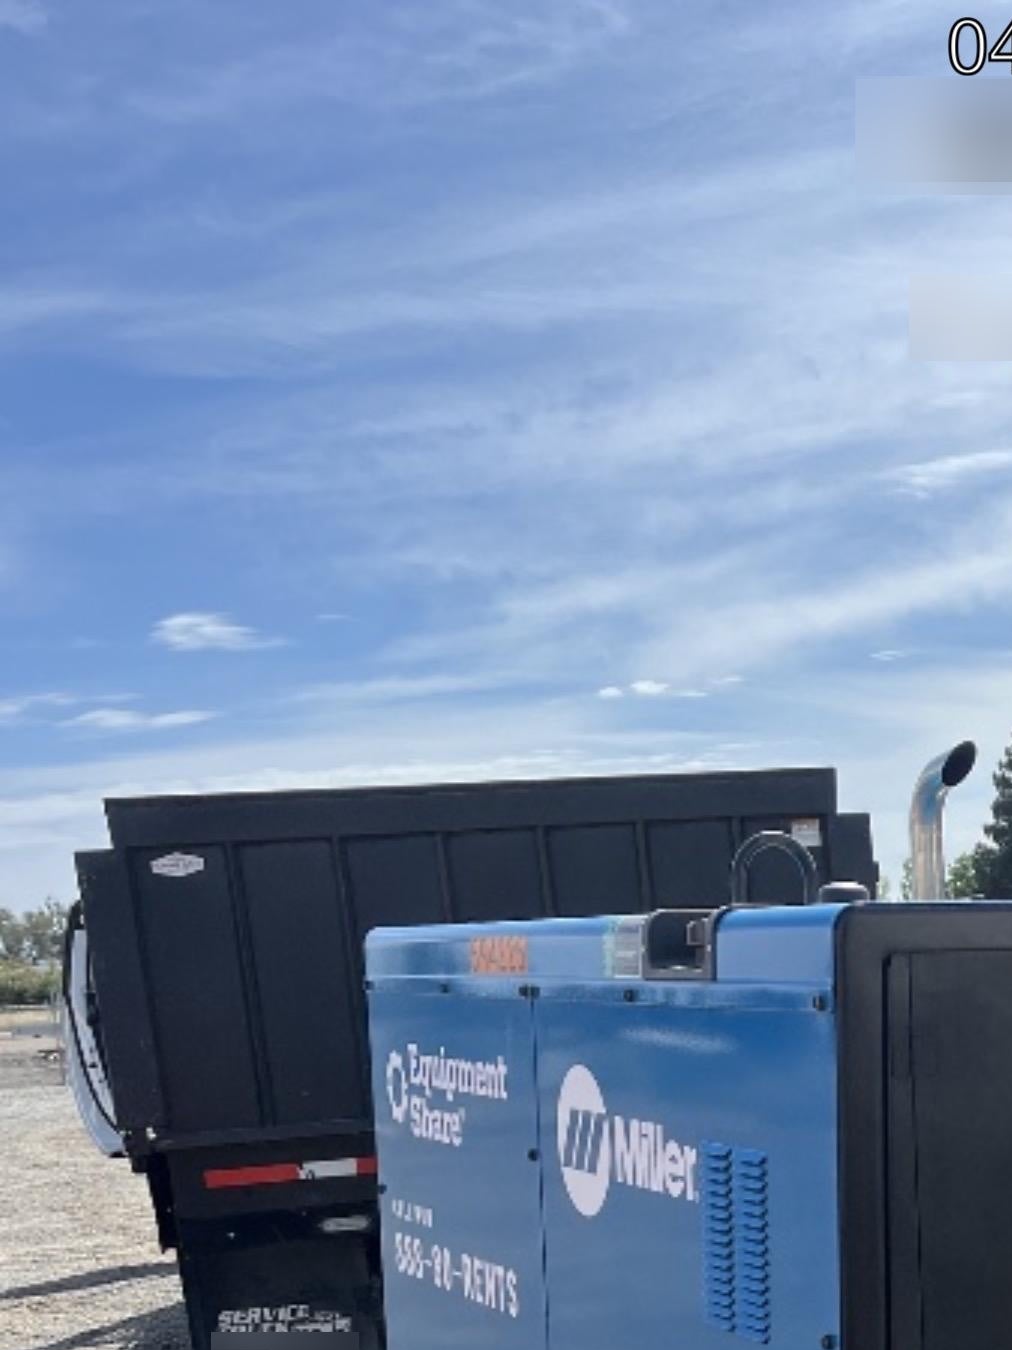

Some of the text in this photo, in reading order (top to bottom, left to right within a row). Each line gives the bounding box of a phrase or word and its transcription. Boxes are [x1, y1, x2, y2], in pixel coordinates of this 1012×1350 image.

[406, 1043, 508, 1101] Equipment
[408, 1097, 463, 1147] Share
[613, 1115, 698, 1202] Miller
[218, 1304, 310, 1325] SERVICE
